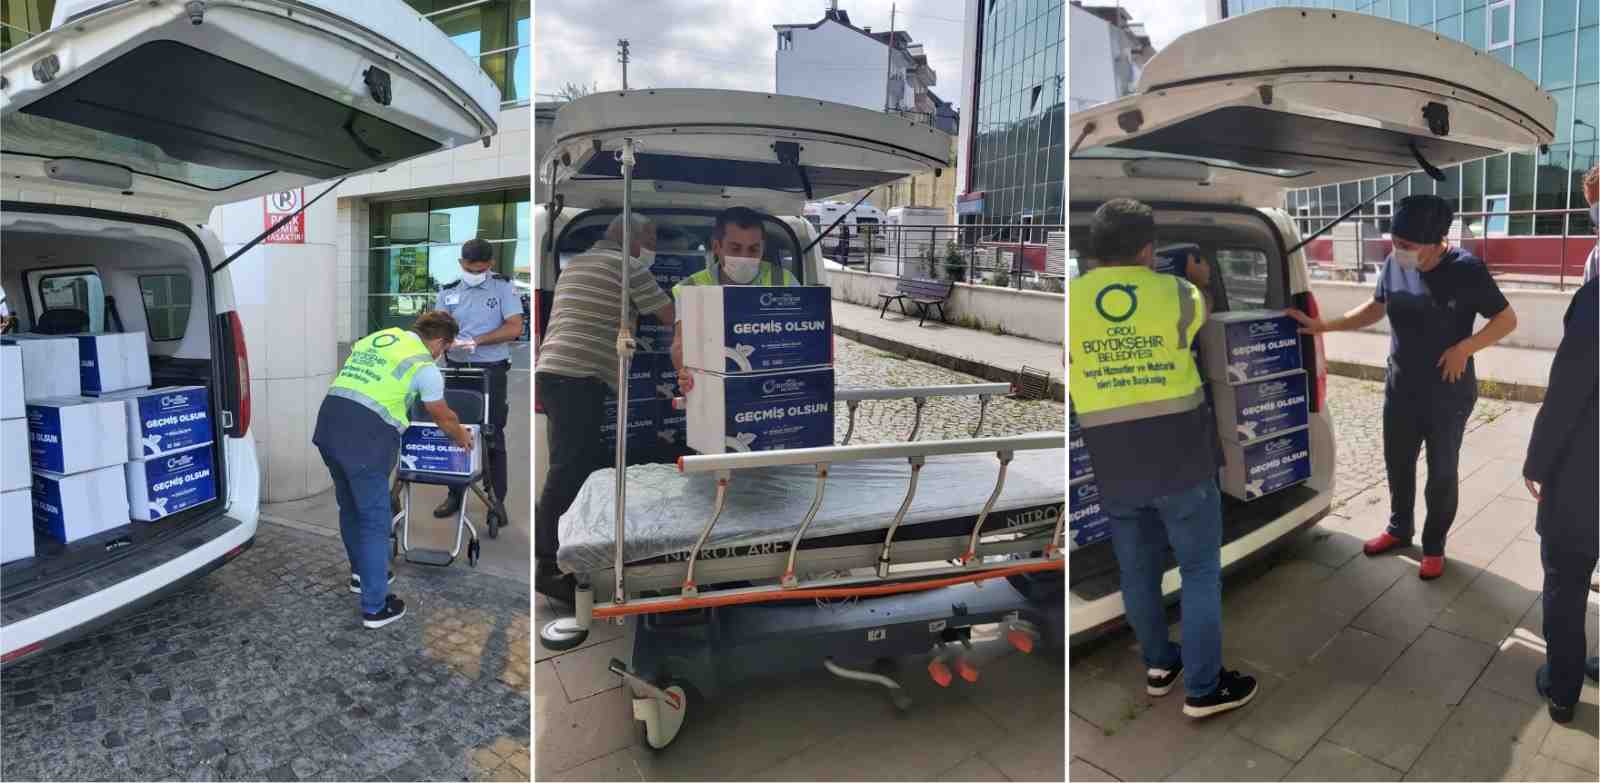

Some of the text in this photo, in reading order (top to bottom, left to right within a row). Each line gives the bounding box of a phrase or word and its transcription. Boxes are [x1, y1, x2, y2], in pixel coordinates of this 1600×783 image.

[271, 214, 299, 227] PAK
[733, 320, 825, 335] GEÇMİŞ OLSUN
[1106, 326, 1136, 337] ORDU
[1267, 338, 1297, 350] OLSUN
[1276, 395, 1305, 409] OLSUN
[179, 411, 207, 422] OLSUN
[735, 402, 828, 424] GEÇMİŞ OLSUN
[1281, 450, 1308, 465] OLSUN
[184, 468, 210, 483] OLSUN
